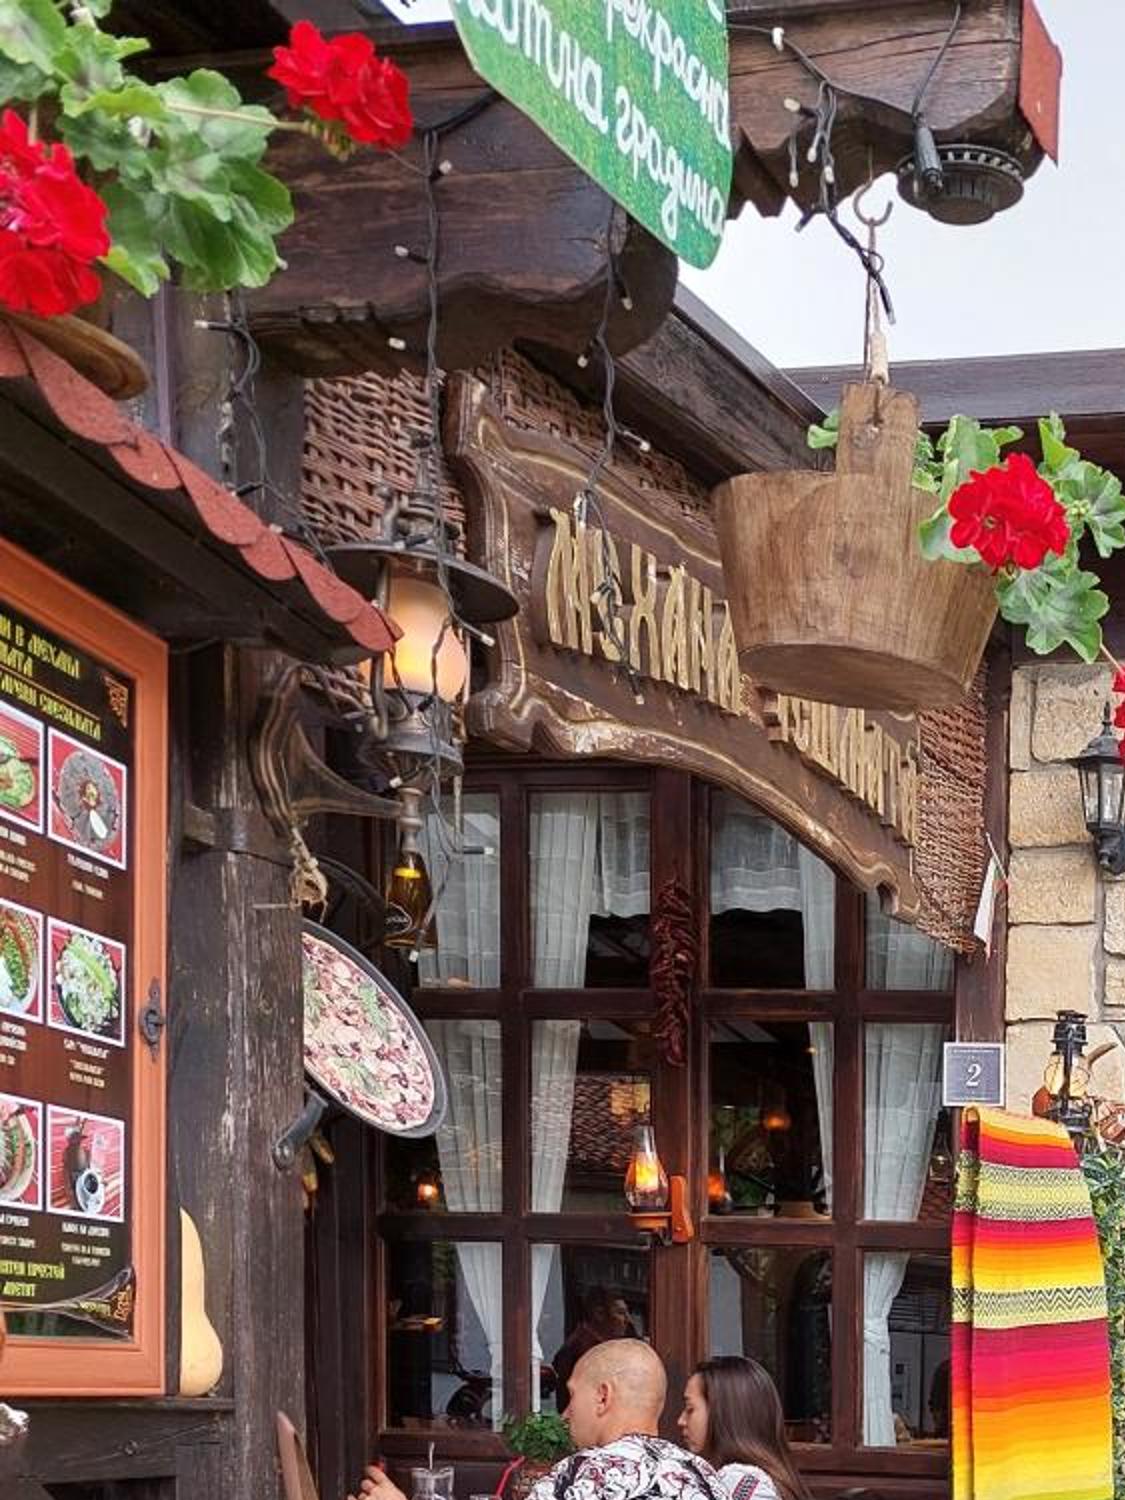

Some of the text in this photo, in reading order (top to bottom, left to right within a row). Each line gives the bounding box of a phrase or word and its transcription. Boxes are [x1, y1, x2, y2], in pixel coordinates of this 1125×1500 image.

[615, 85, 724, 240] градина
[546, 507, 746, 717] МЕХАНА
[965, 1063, 982, 1087] 2
